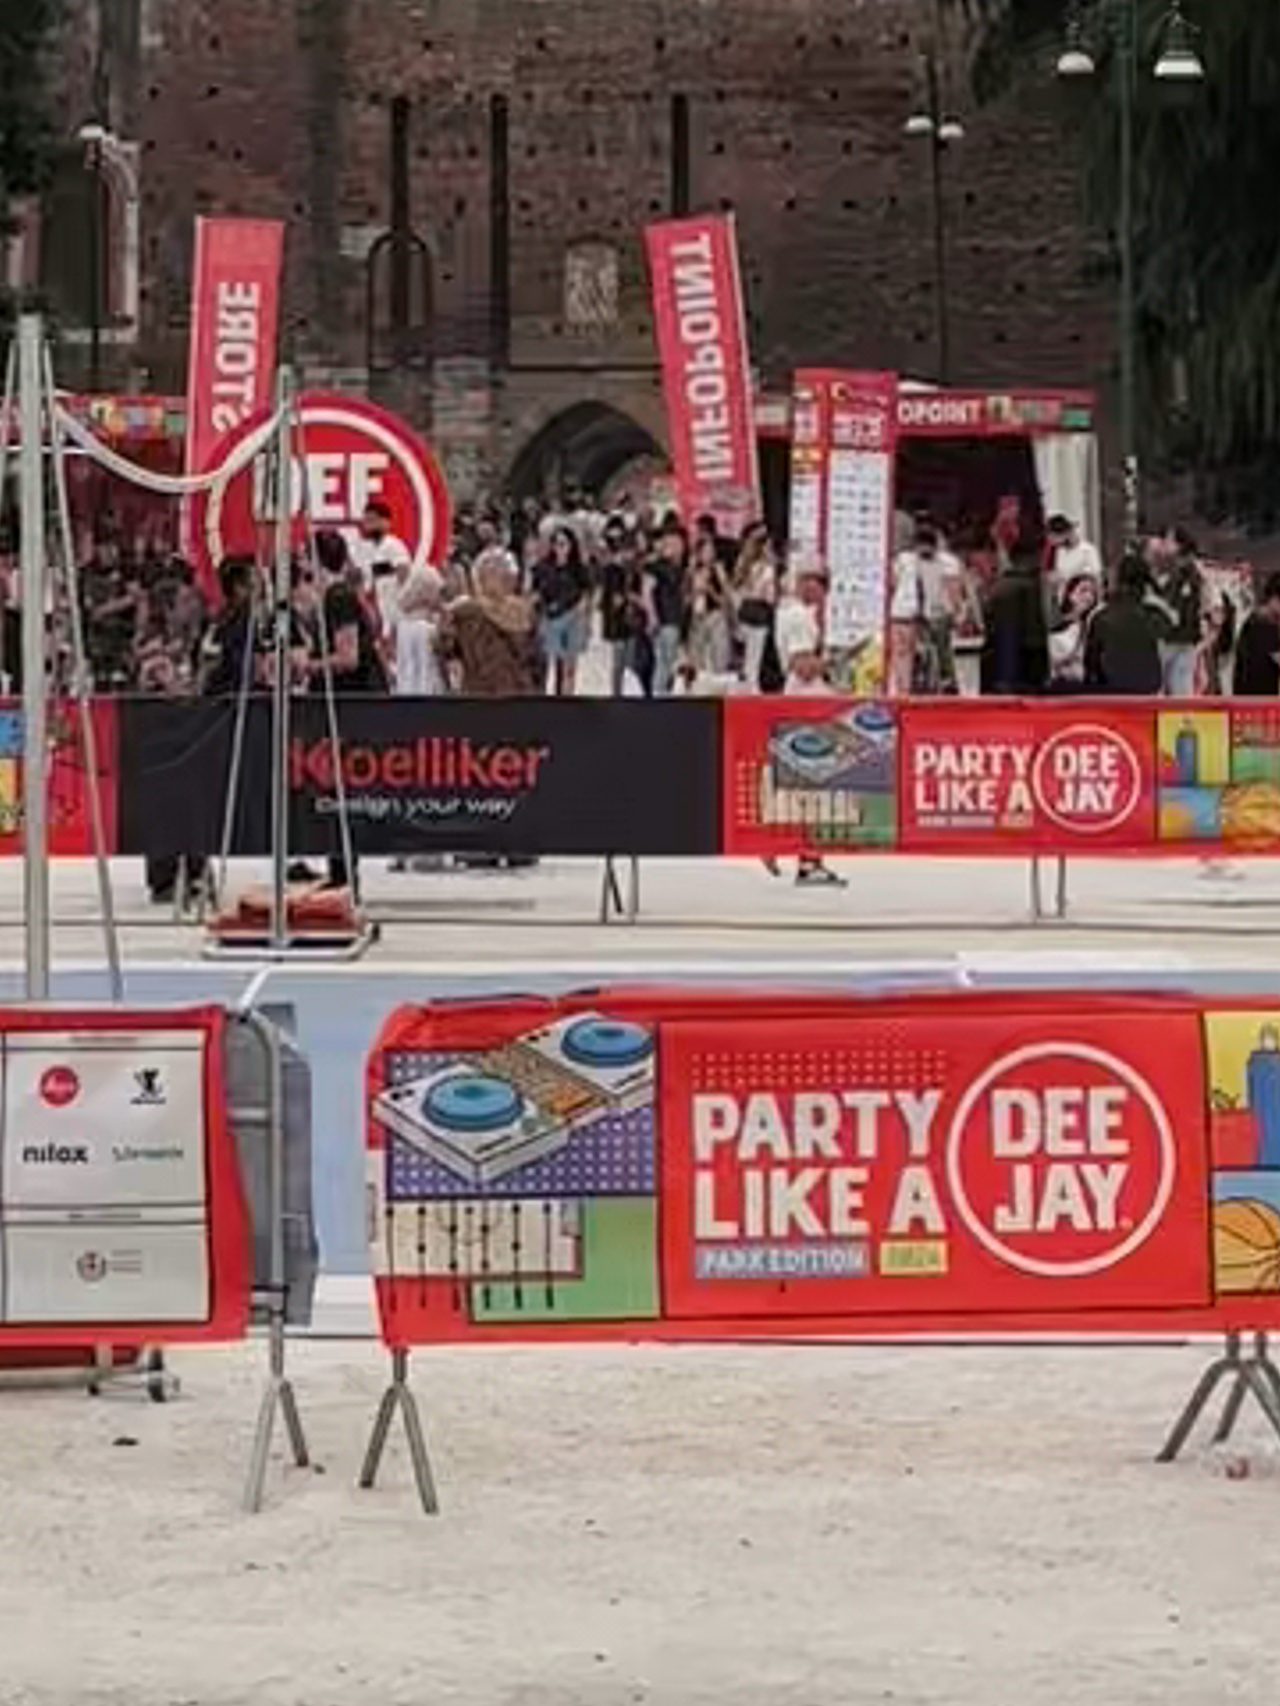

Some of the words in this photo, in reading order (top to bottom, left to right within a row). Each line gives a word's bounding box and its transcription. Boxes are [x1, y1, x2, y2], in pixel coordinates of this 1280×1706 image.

[897, 398, 981, 426] OPOINT
[915, 744, 1032, 776] PARTY
[1054, 744, 1120, 778] DEE
[916, 779, 998, 812] LIKE
[1007, 779, 1034, 812] A
[1055, 780, 1120, 814] JAY
[692, 1088, 942, 1162] PARTY
[991, 1085, 1130, 1157] DEE
[23, 1142, 89, 1164] nilox
[694, 1166, 871, 1239] LIKE
[888, 1164, 947, 1236] A
[994, 1162, 1130, 1233] JAY
